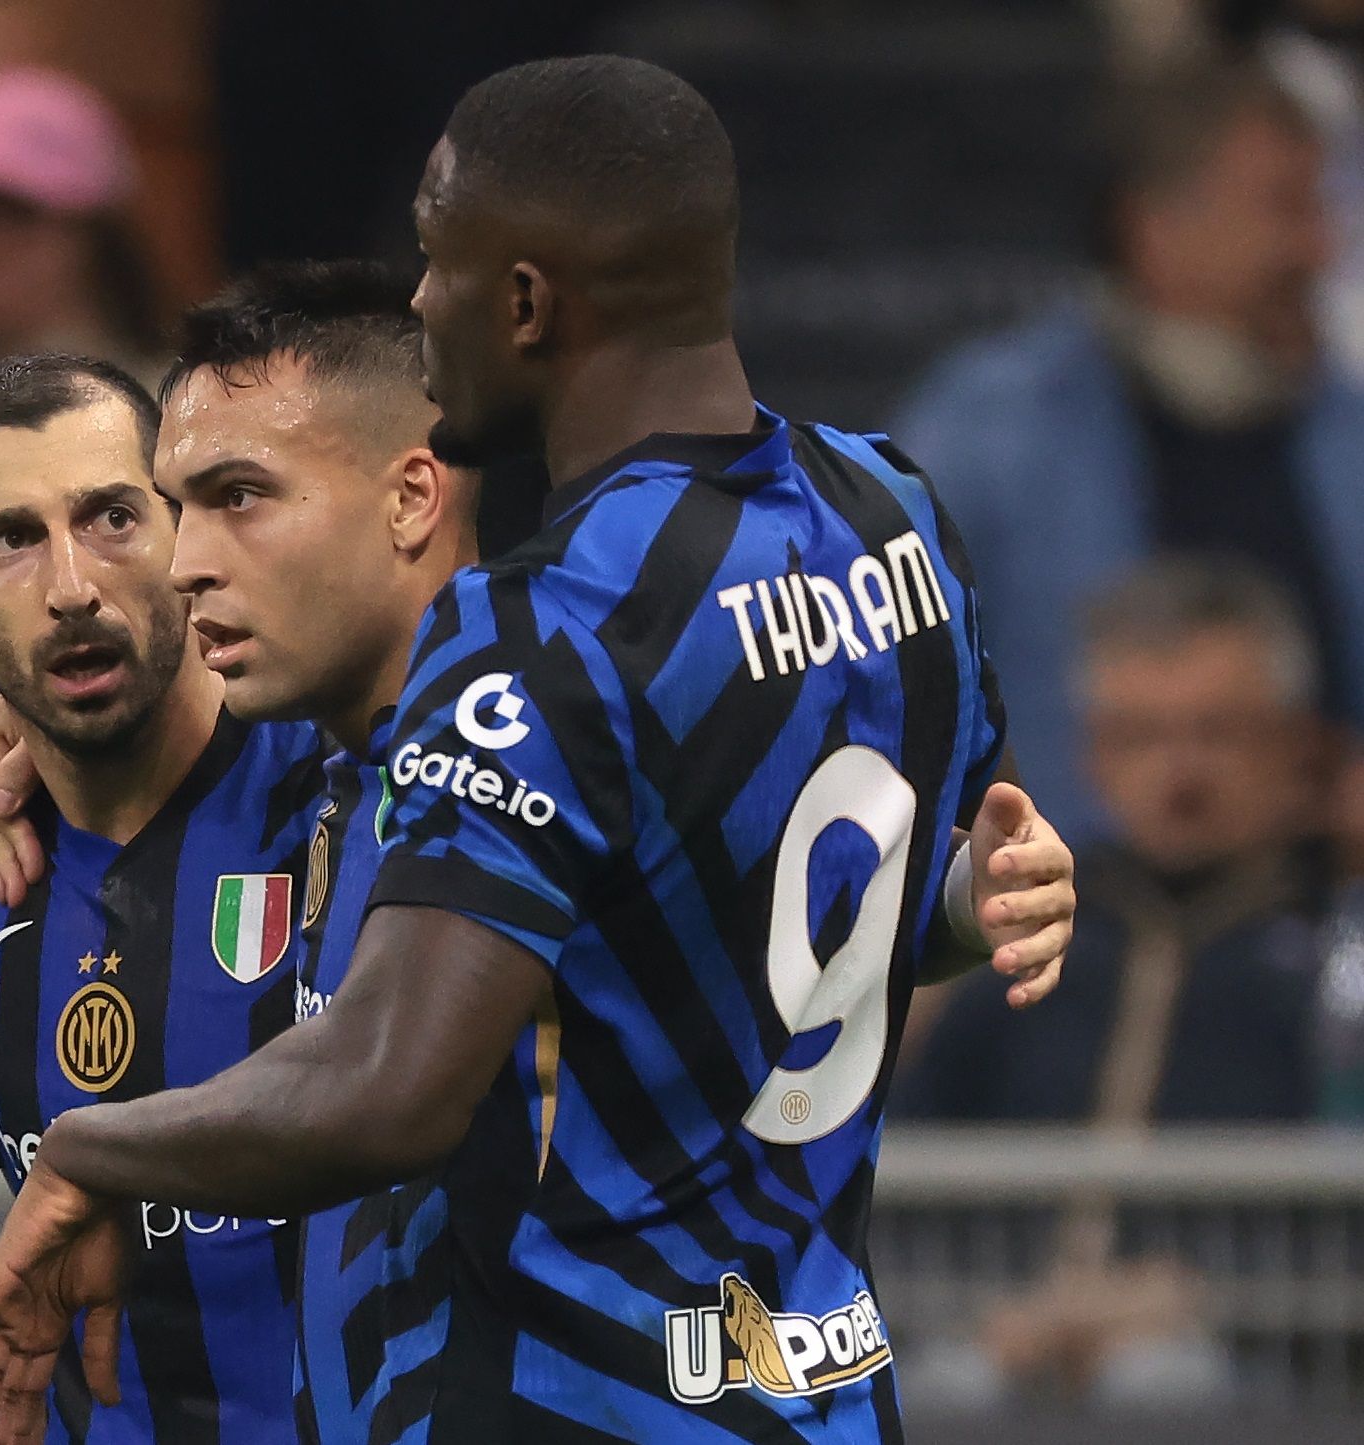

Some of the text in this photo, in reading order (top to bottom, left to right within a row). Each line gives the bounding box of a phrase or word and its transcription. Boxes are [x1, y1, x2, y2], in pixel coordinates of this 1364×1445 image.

[716, 529, 951, 682] THURAM
[393, 743, 556, 827] Gate.io
[741, 745, 917, 1143] 9
